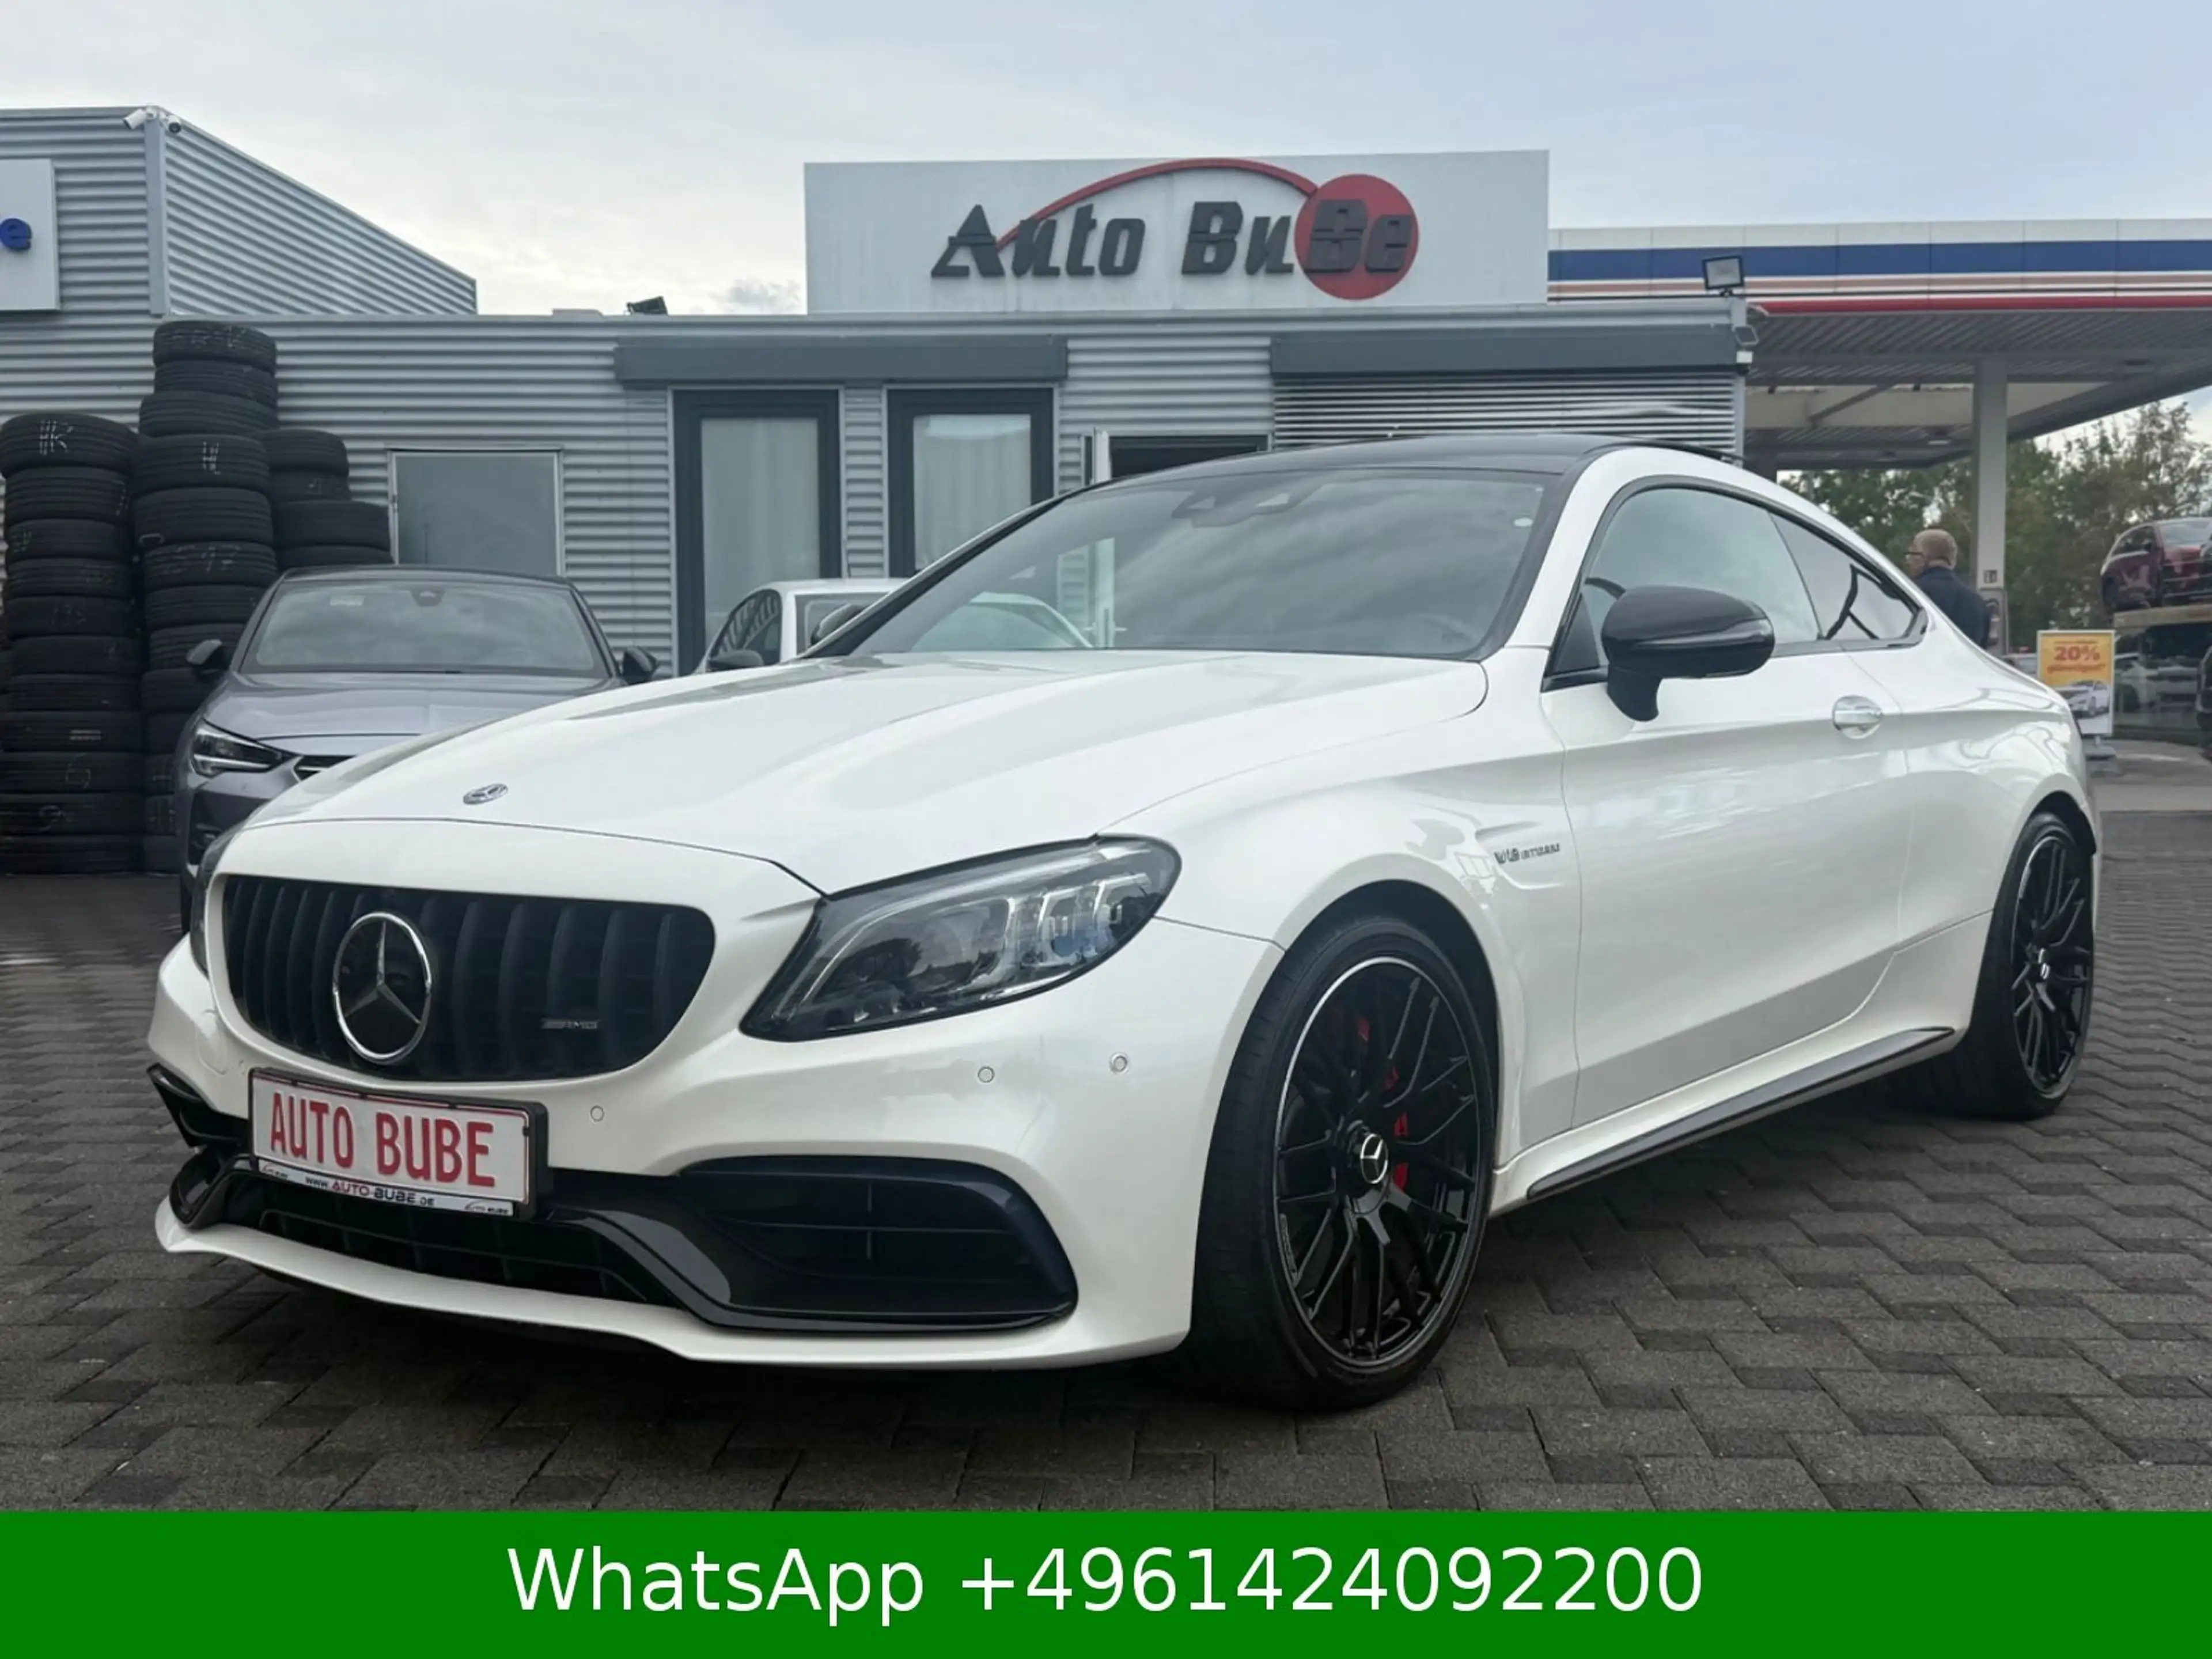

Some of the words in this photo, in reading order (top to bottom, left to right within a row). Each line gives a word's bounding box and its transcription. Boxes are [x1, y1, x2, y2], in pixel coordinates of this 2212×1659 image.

[930, 203, 1146, 278] Auto
[2054, 646, 2100, 661] 20%
[270, 1092, 354, 1169] AUTO
[376, 1112, 495, 1187] BUBE
